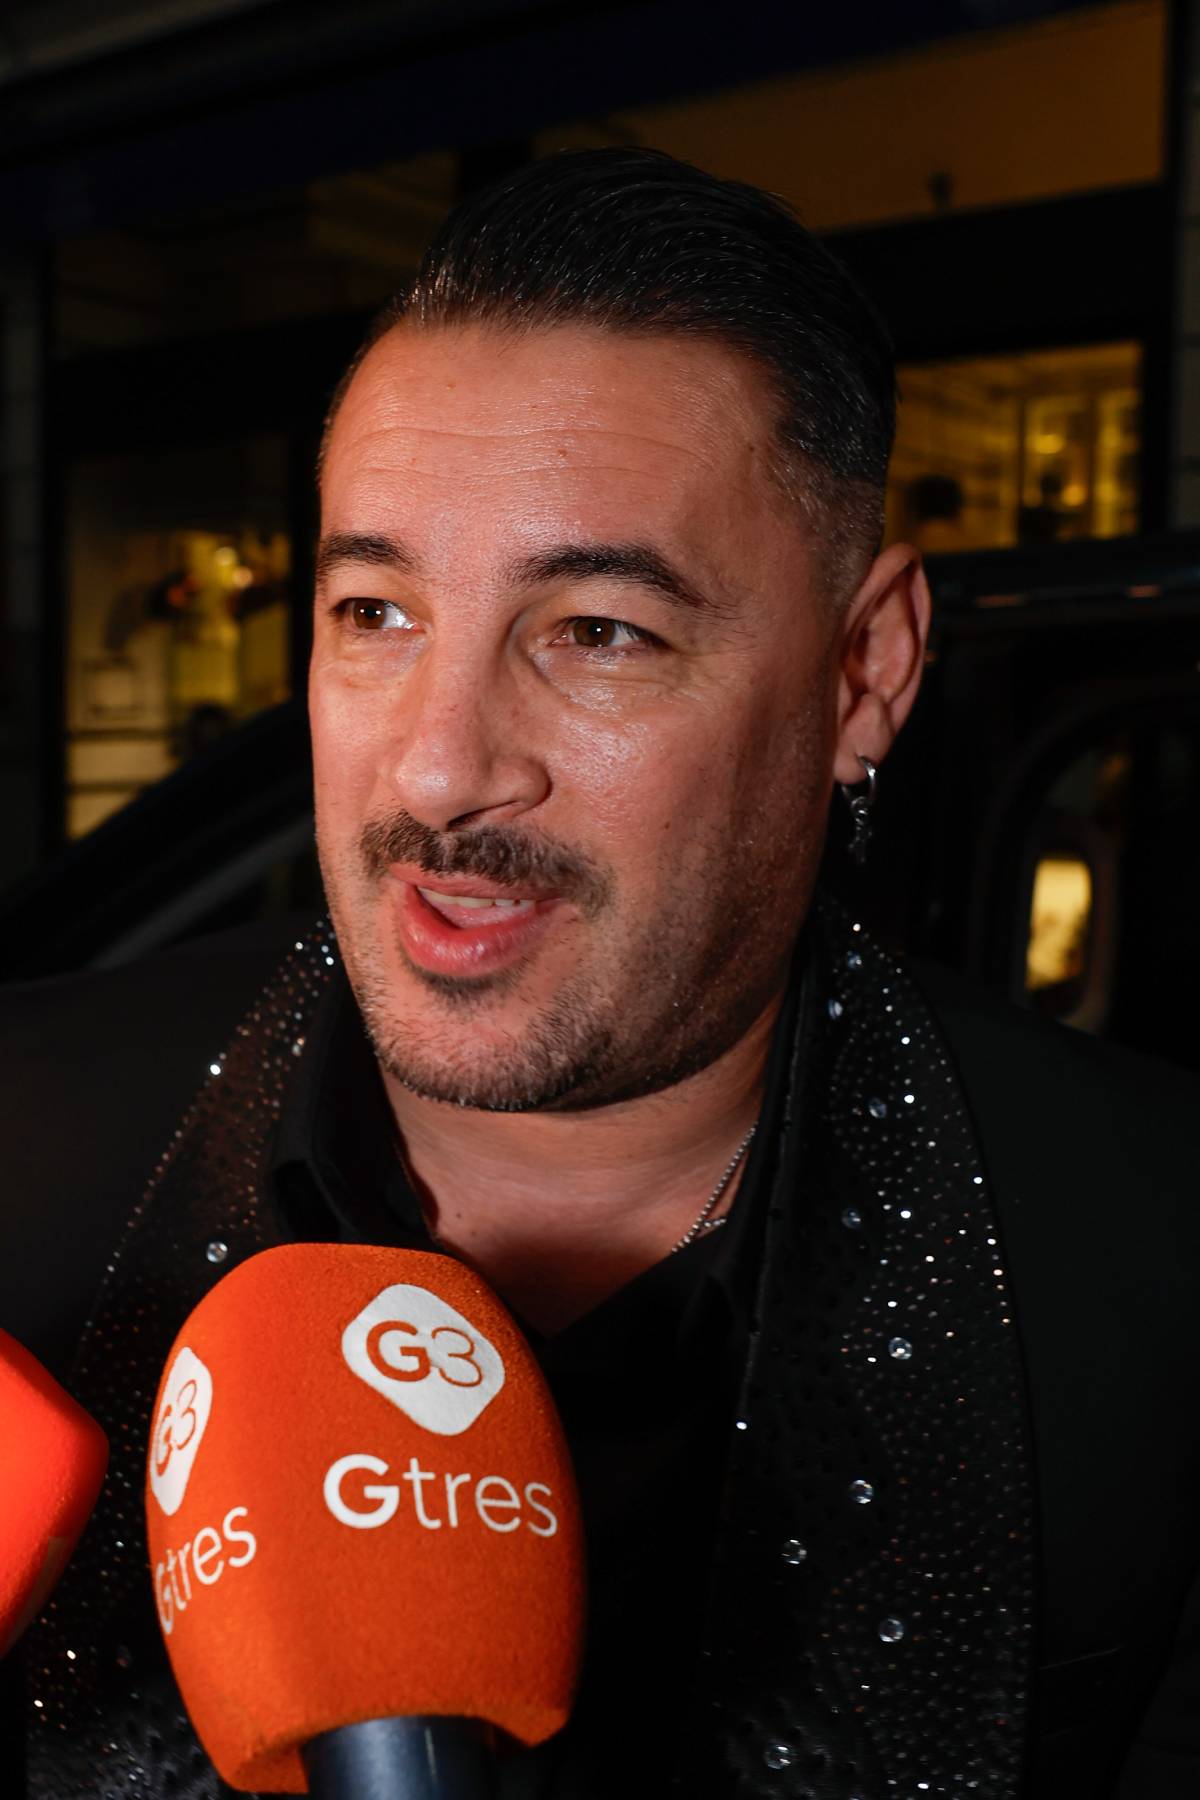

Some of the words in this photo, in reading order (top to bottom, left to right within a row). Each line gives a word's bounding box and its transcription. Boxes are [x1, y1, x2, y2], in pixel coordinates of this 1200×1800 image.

[365, 1320, 483, 1388] G3
[323, 1453, 558, 1538] Gtres
[154, 1506, 257, 1635] Gtres
